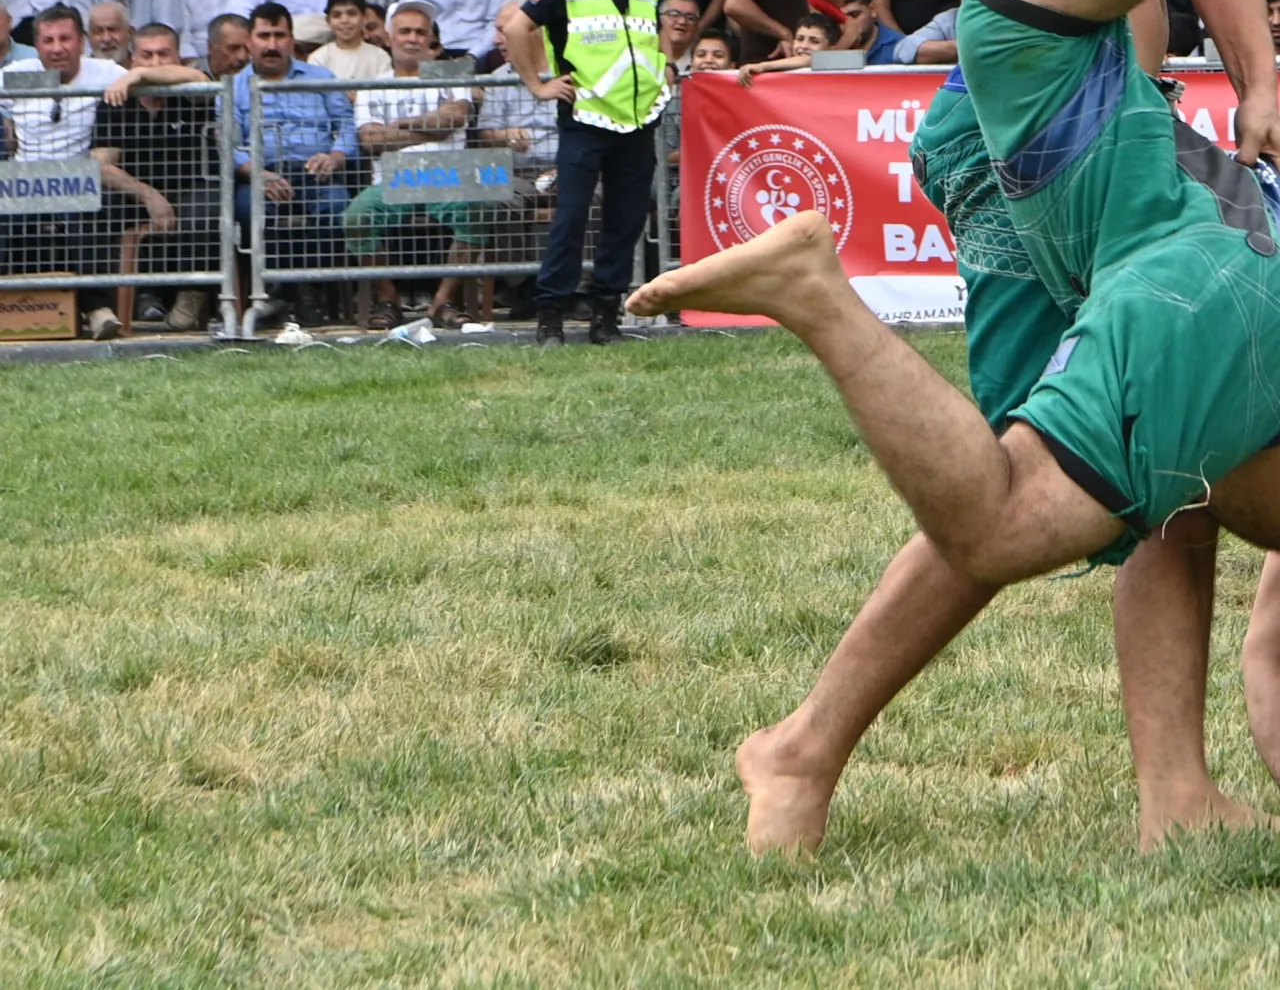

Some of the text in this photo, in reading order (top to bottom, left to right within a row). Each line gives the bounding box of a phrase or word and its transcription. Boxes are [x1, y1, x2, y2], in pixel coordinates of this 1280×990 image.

[762, 153, 804, 170] GENÇLİK
[802, 164, 815, 180] VE
[809, 176, 827, 205] SPOR
